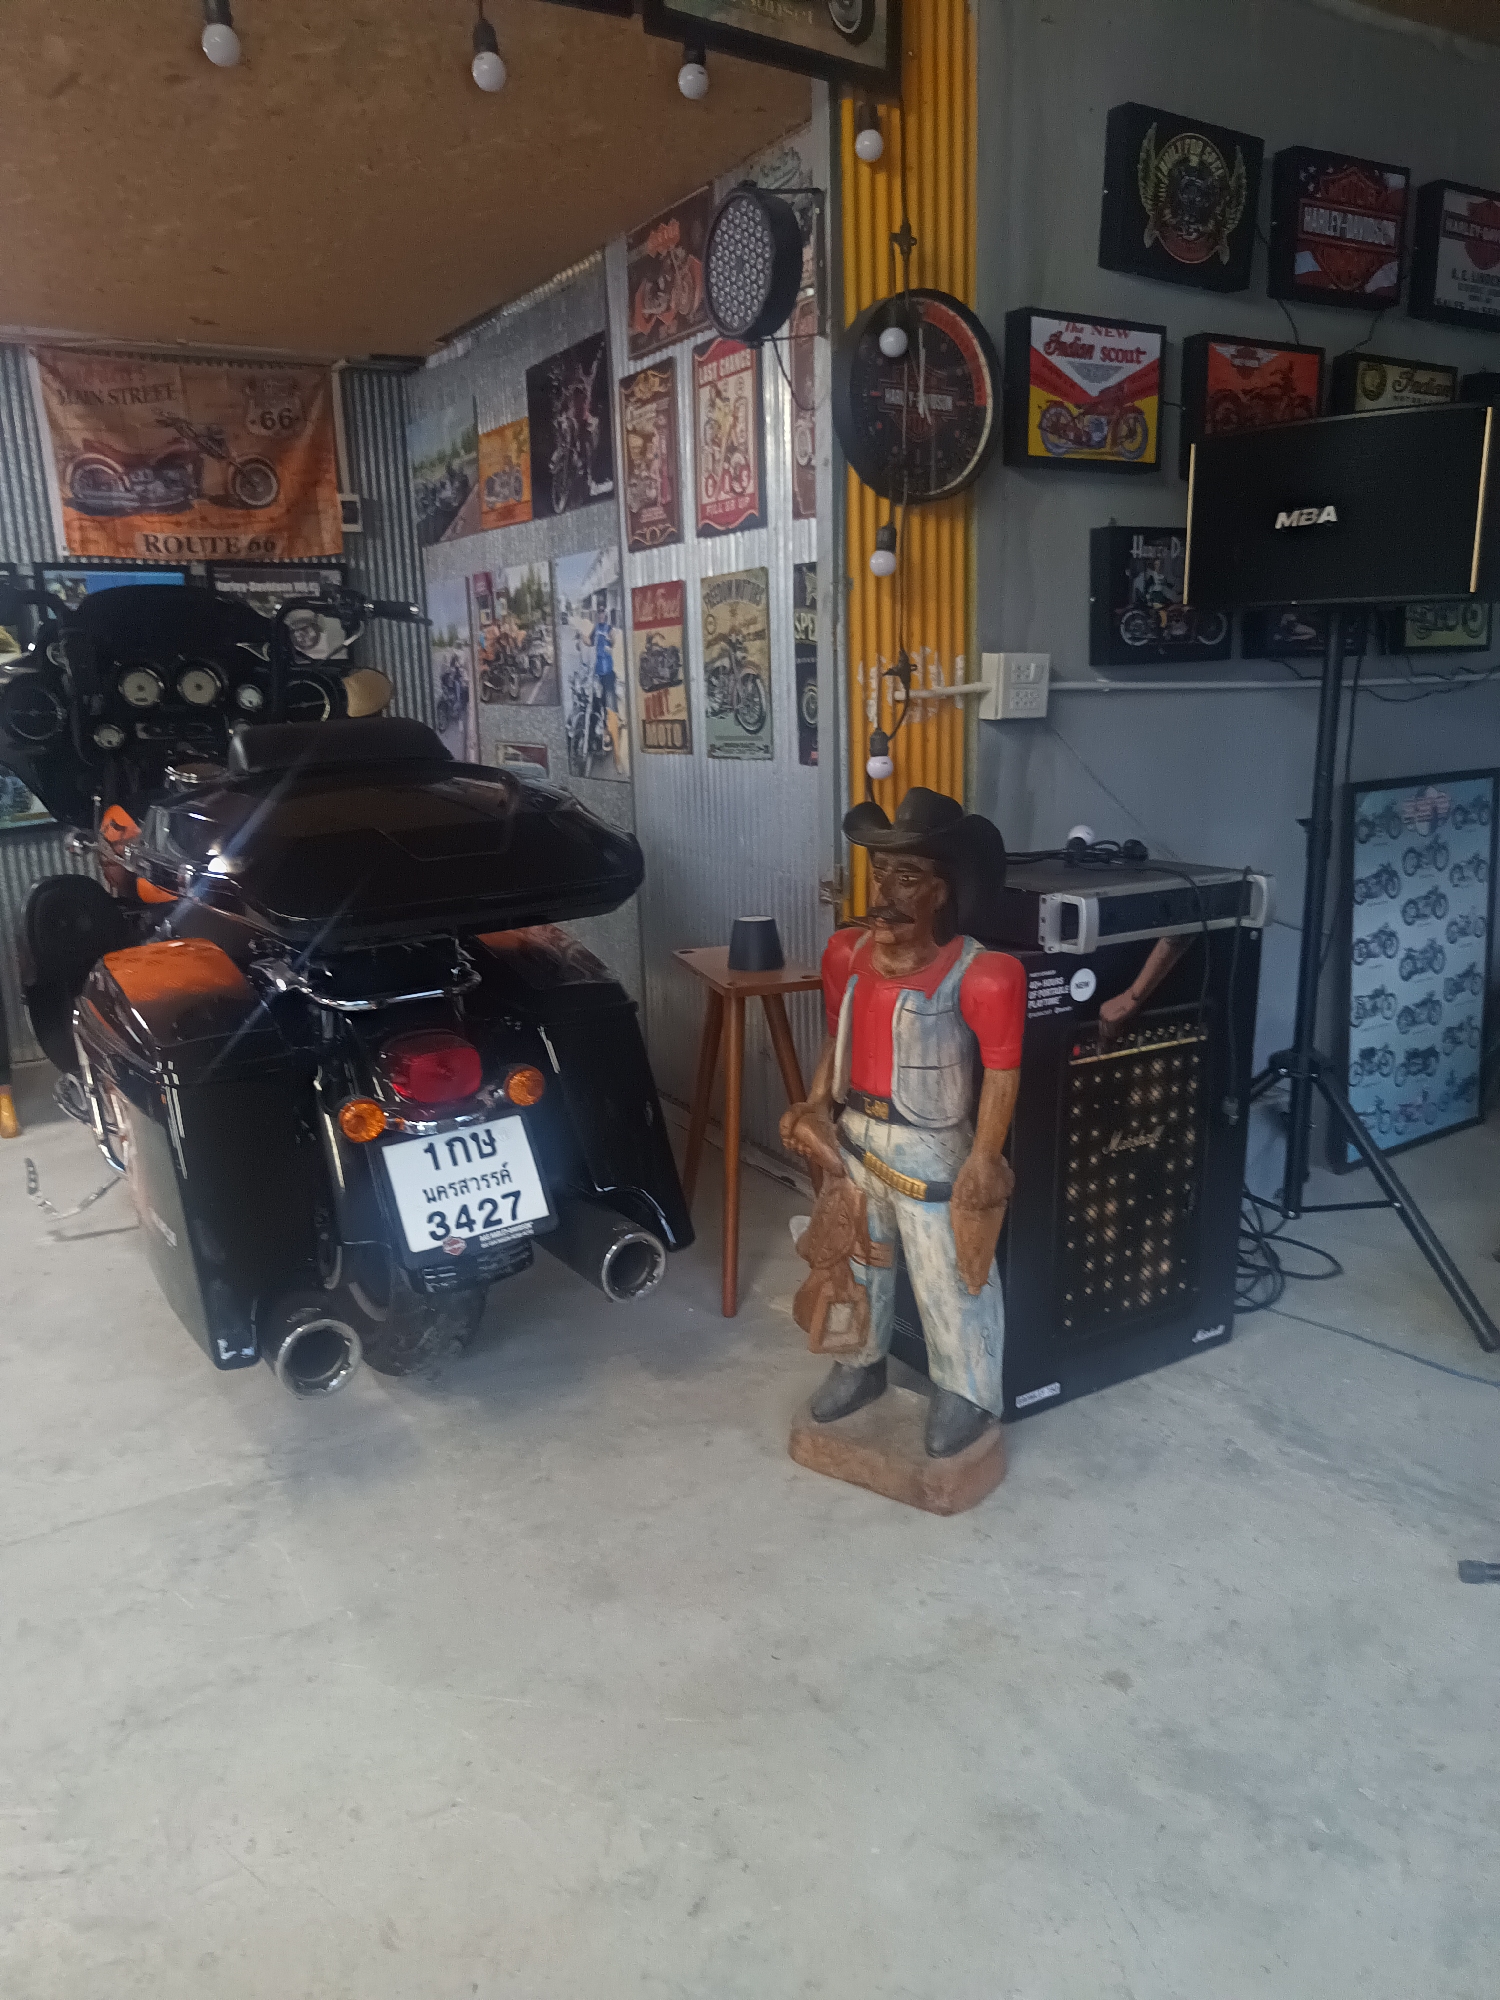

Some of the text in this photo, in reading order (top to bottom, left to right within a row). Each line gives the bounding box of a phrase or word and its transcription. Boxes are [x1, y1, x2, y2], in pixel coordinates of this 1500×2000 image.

[1091, 325, 1130, 339] NEW
[1100, 346, 1147, 365] scout
[260, 407, 293, 430] 66
[1275, 505, 1338, 529] MBA
[143, 534, 276, 555] ROUTE 66
[424, 1129, 497, 1170] 1กษ
[422, 1162, 513, 1203] นครสวรรค์
[427, 1190, 521, 1241] 3427
